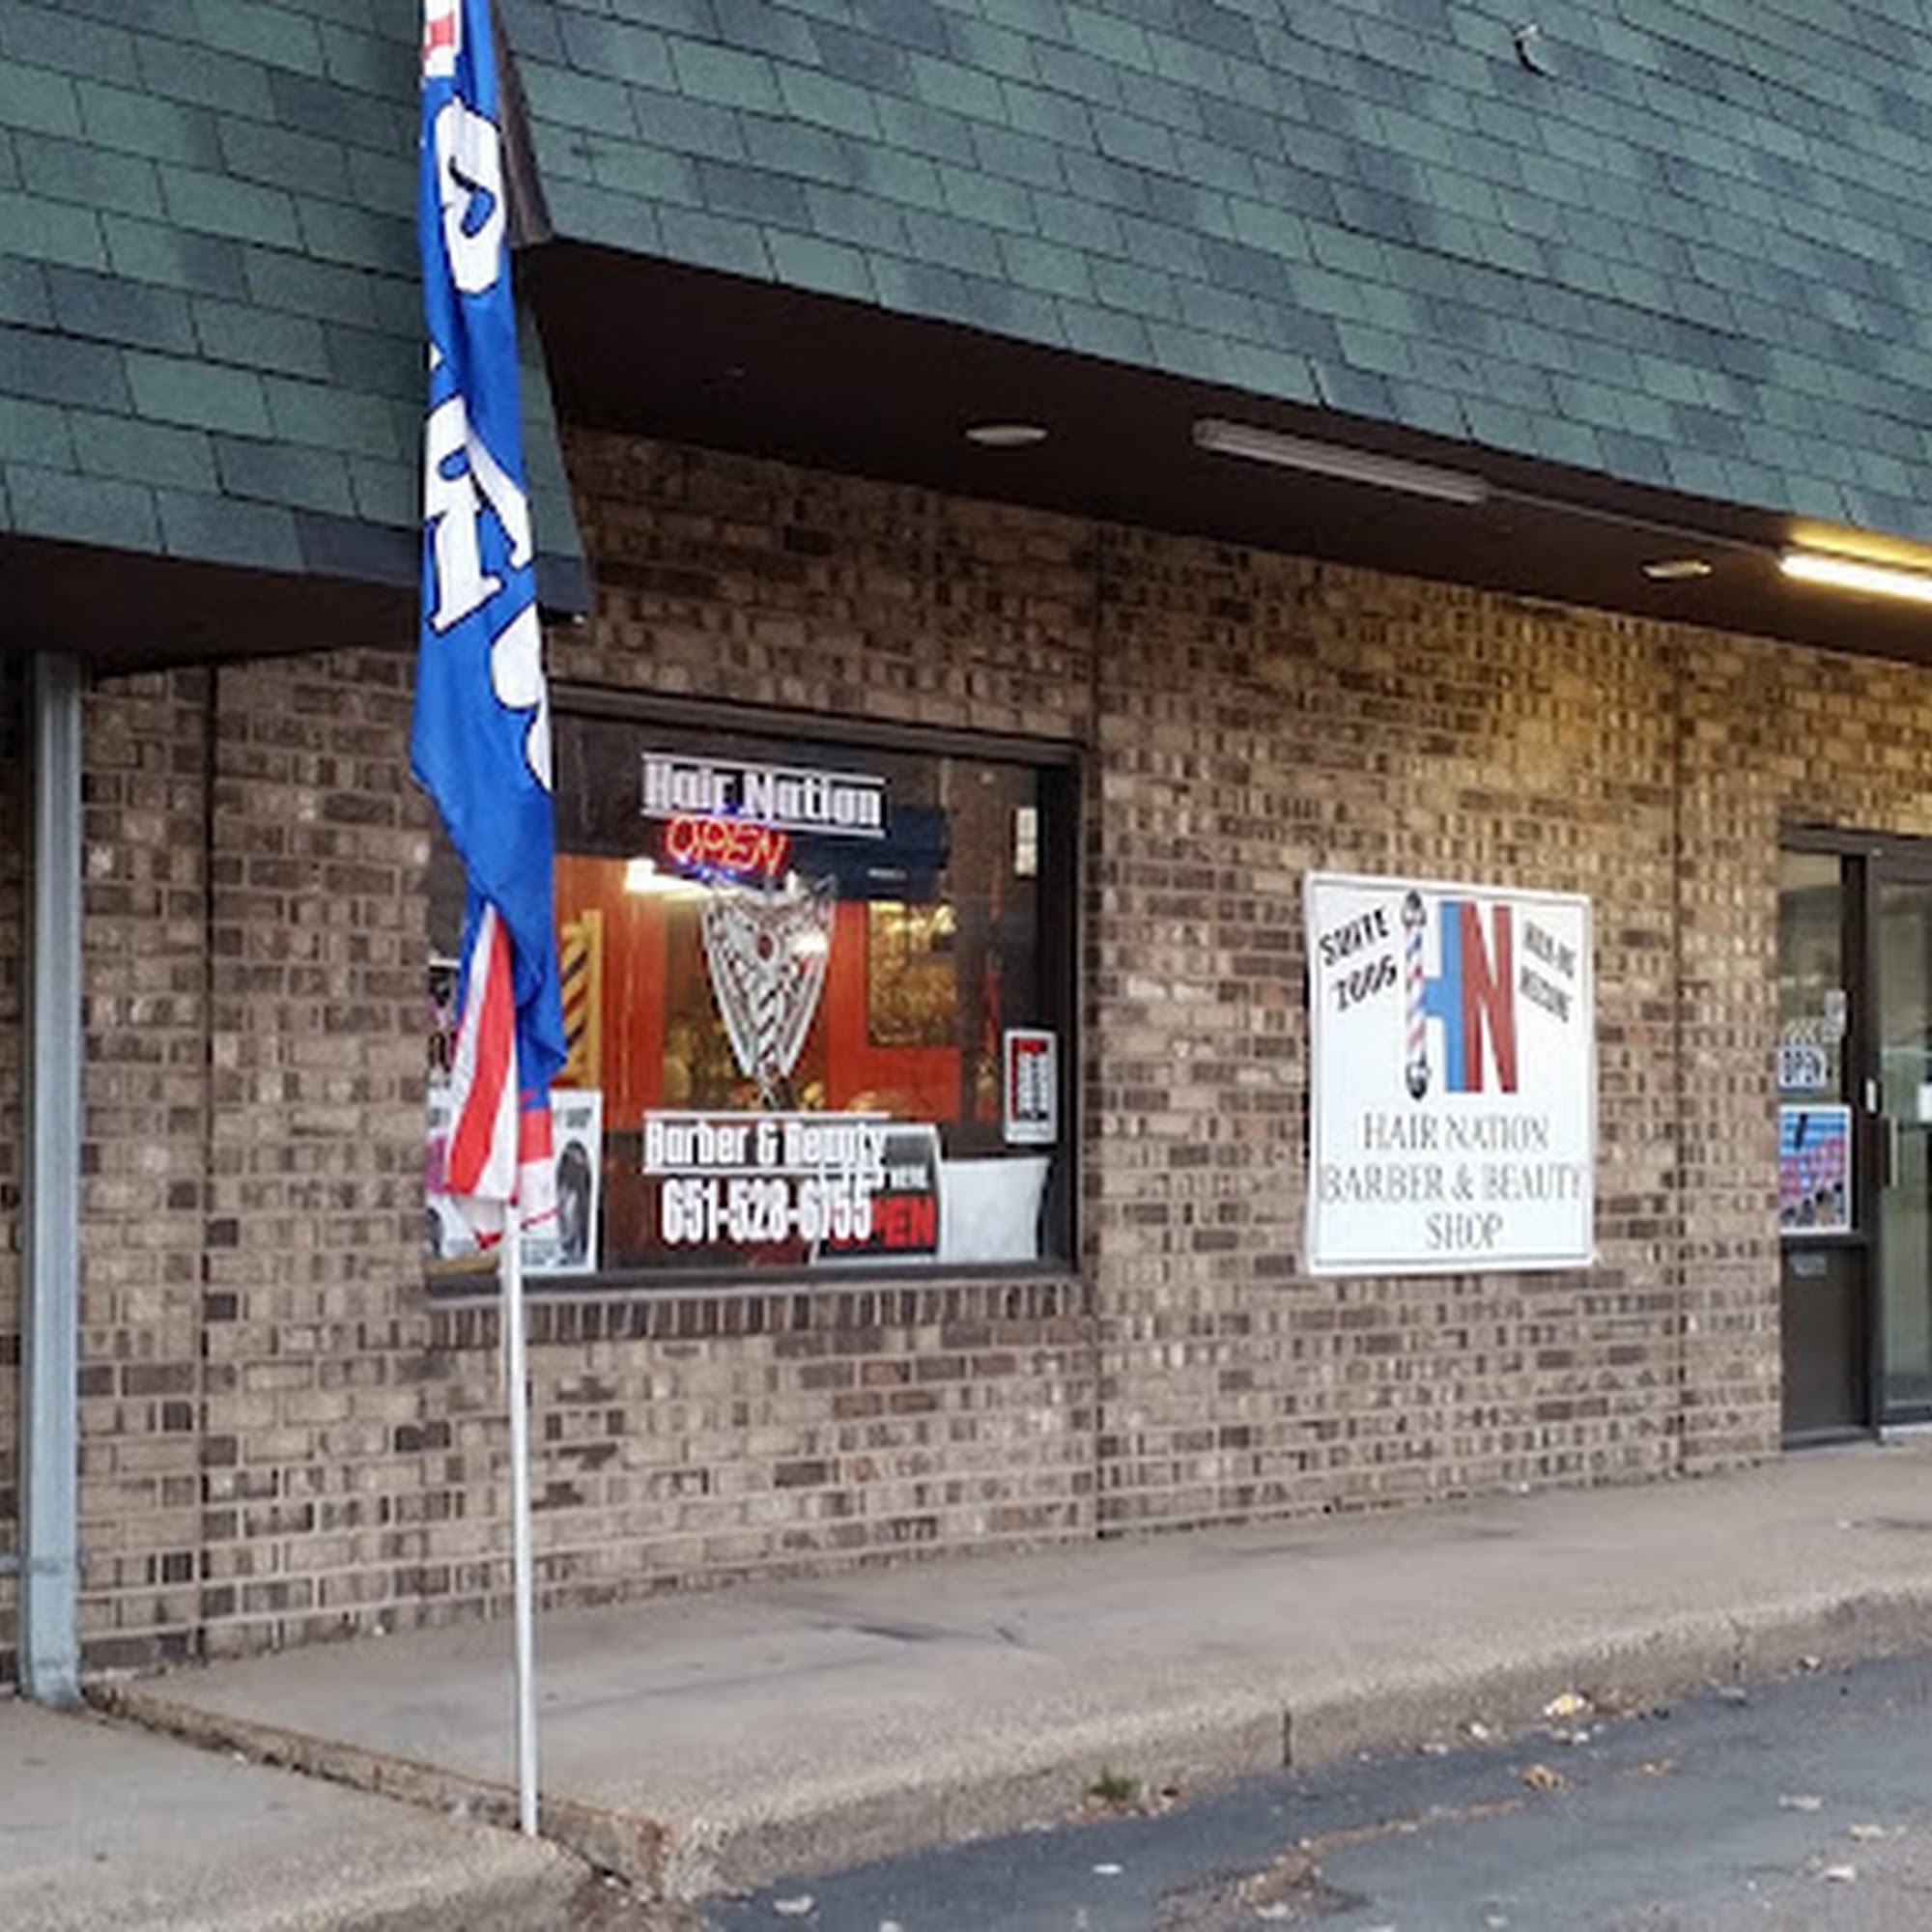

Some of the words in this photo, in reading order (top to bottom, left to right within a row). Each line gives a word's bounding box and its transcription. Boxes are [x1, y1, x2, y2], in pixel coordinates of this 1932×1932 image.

[644, 760, 734, 812] Hair
[744, 771, 882, 829] Nation
[665, 816, 790, 875] OPEN
[1320, 905, 1389, 966] SUITE
[645, 1122, 748, 1165] Barber
[758, 1125, 779, 1165] &
[1364, 1113, 1438, 1150] HAIR
[1446, 1115, 1548, 1151] NATION
[1321, 1163, 1444, 1204] BARBER
[1451, 1164, 1474, 1200] &
[1483, 1165, 1581, 1201] BEAUTY
[1425, 1212, 1503, 1251] SHOP
